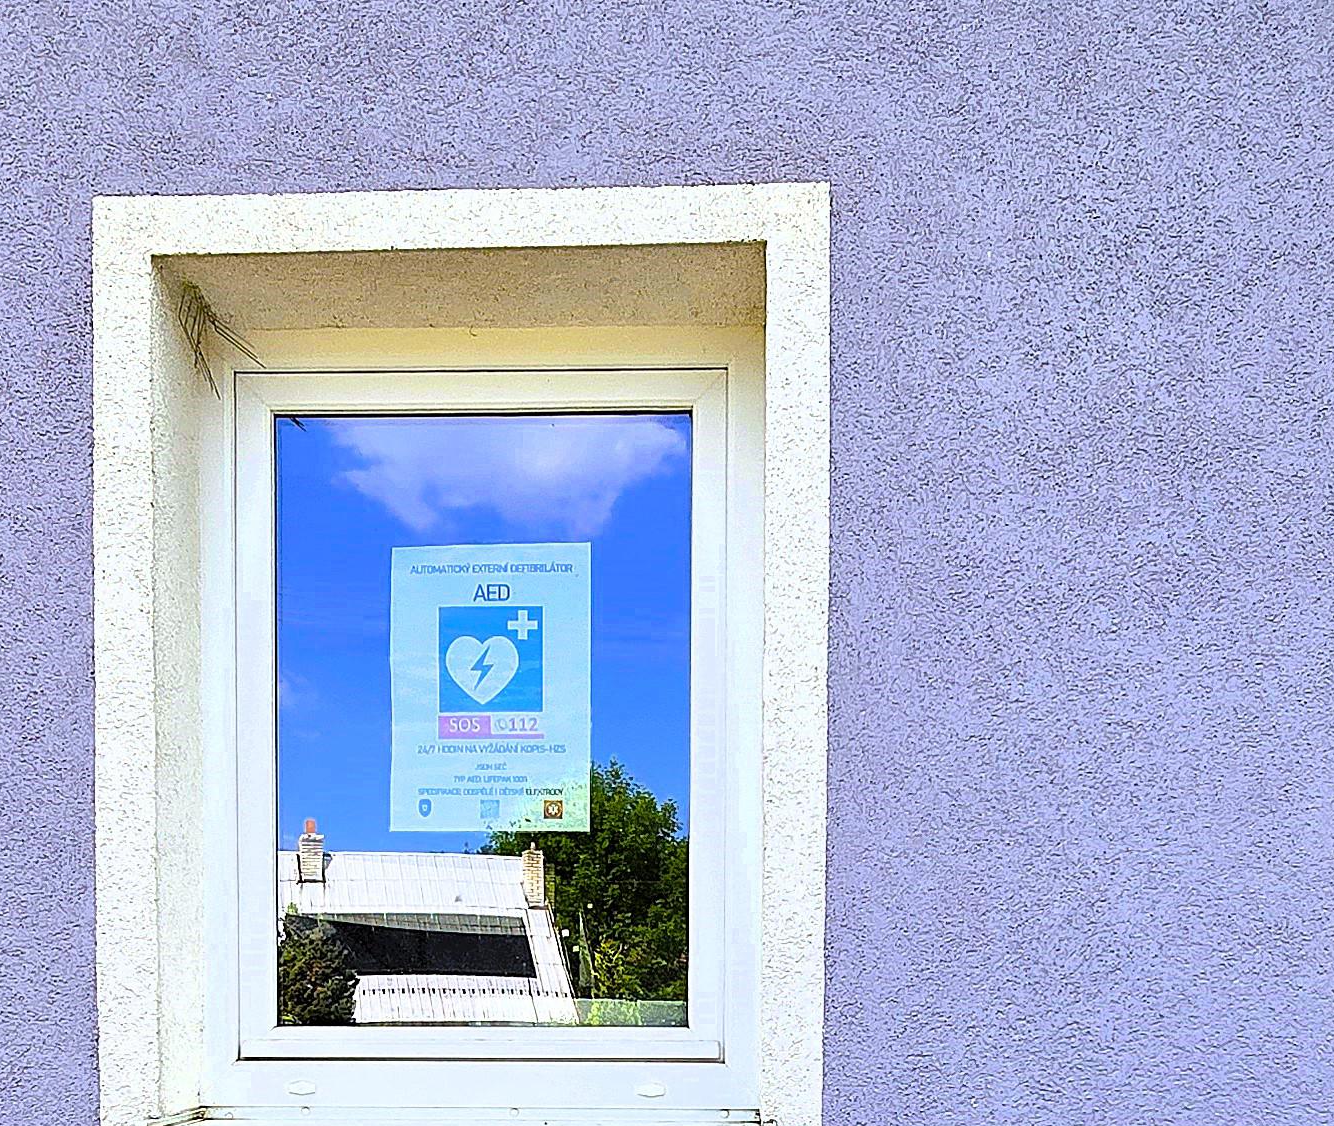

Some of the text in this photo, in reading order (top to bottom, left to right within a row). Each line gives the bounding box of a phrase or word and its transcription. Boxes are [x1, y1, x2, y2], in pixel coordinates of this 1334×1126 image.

[410, 560, 573, 575] AUTOMATICKÝ EXTERNÍ DEFIBRILÁTOR
[473, 583, 510, 602] AED
[448, 717, 538, 733] SOS 112
[465, 744, 477, 754] NA
